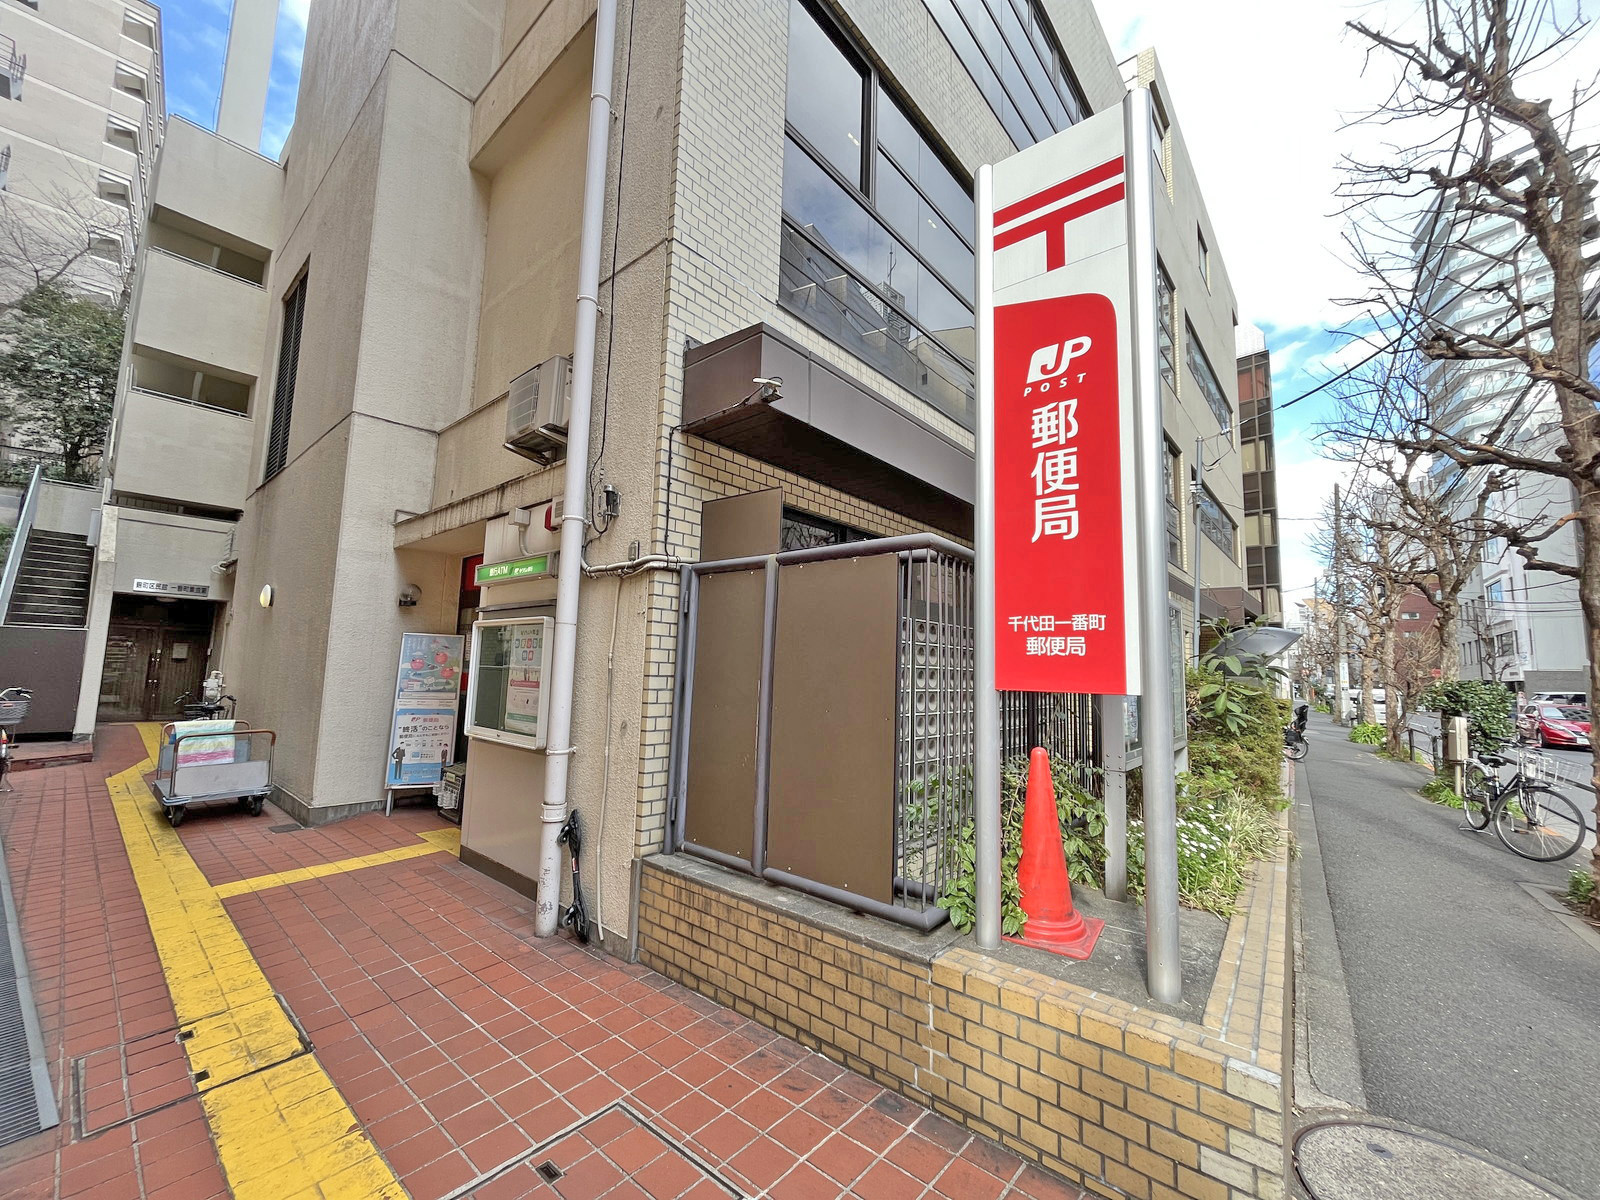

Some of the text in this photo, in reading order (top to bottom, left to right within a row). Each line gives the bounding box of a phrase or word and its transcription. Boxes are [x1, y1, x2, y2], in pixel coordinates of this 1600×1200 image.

[1026, 335, 1092, 384] JP
[1023, 372, 1087, 398] POST
[1030, 398, 1080, 544] 郵便局
[1007, 613, 1107, 632] 千代田一番町
[1026, 636, 1087, 657] 郵便局
